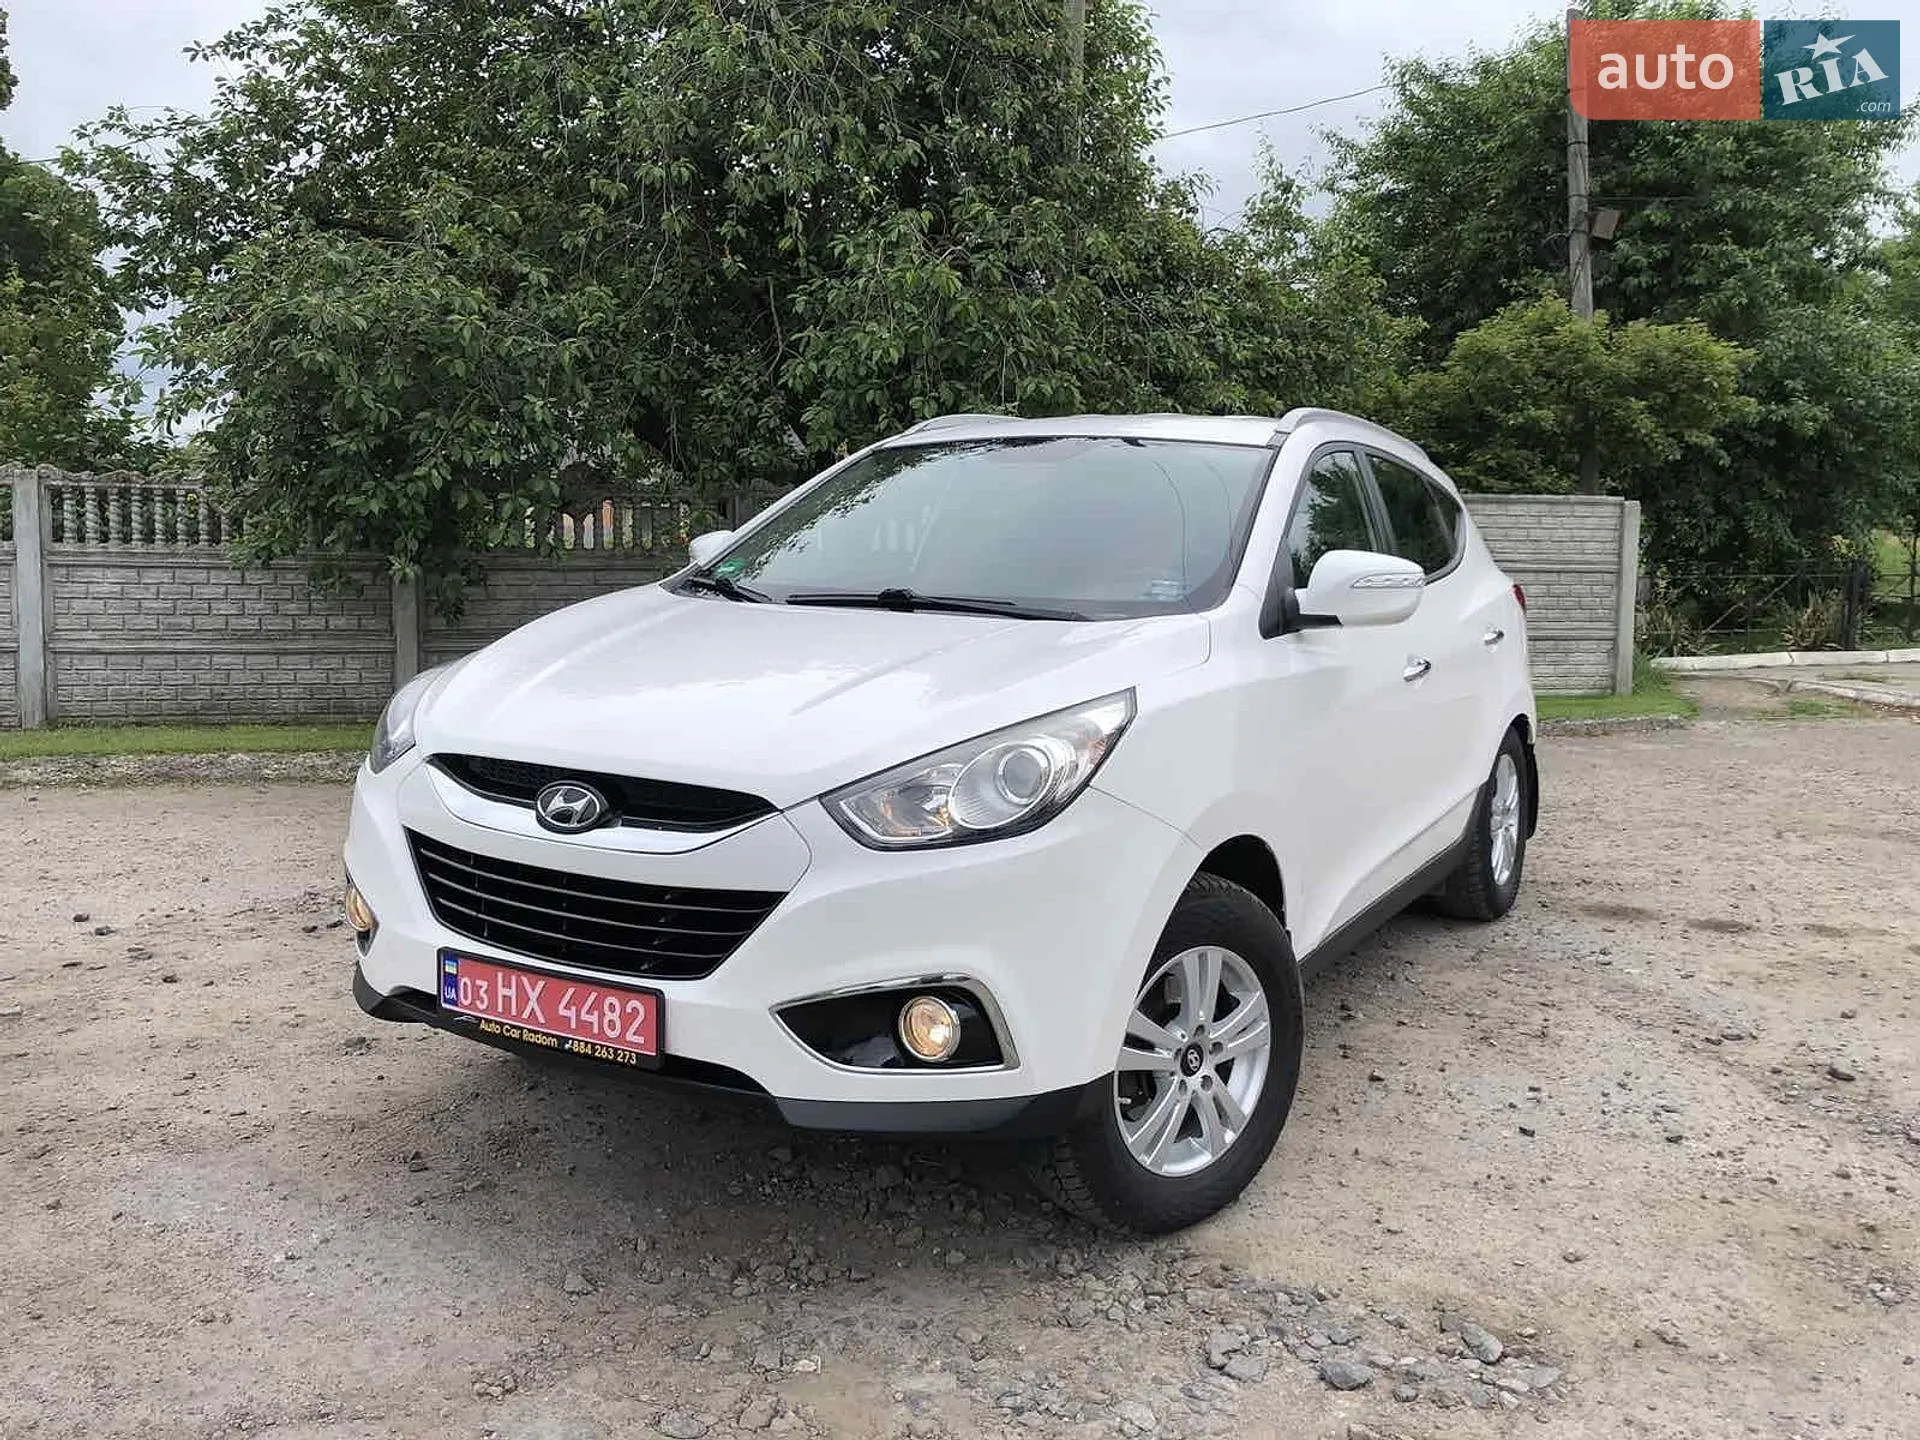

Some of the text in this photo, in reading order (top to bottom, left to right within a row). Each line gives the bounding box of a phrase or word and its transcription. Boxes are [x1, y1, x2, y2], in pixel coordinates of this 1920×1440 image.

[444, 987, 457, 1000] UA
[460, 972, 645, 1044] 03 HX 4482
[479, 1020, 501, 1035] Auto
[503, 1026, 521, 1039] Car
[522, 1030, 558, 1048] Radom
[594, 1044, 615, 1060] 263
[617, 1049, 637, 1064] 273
